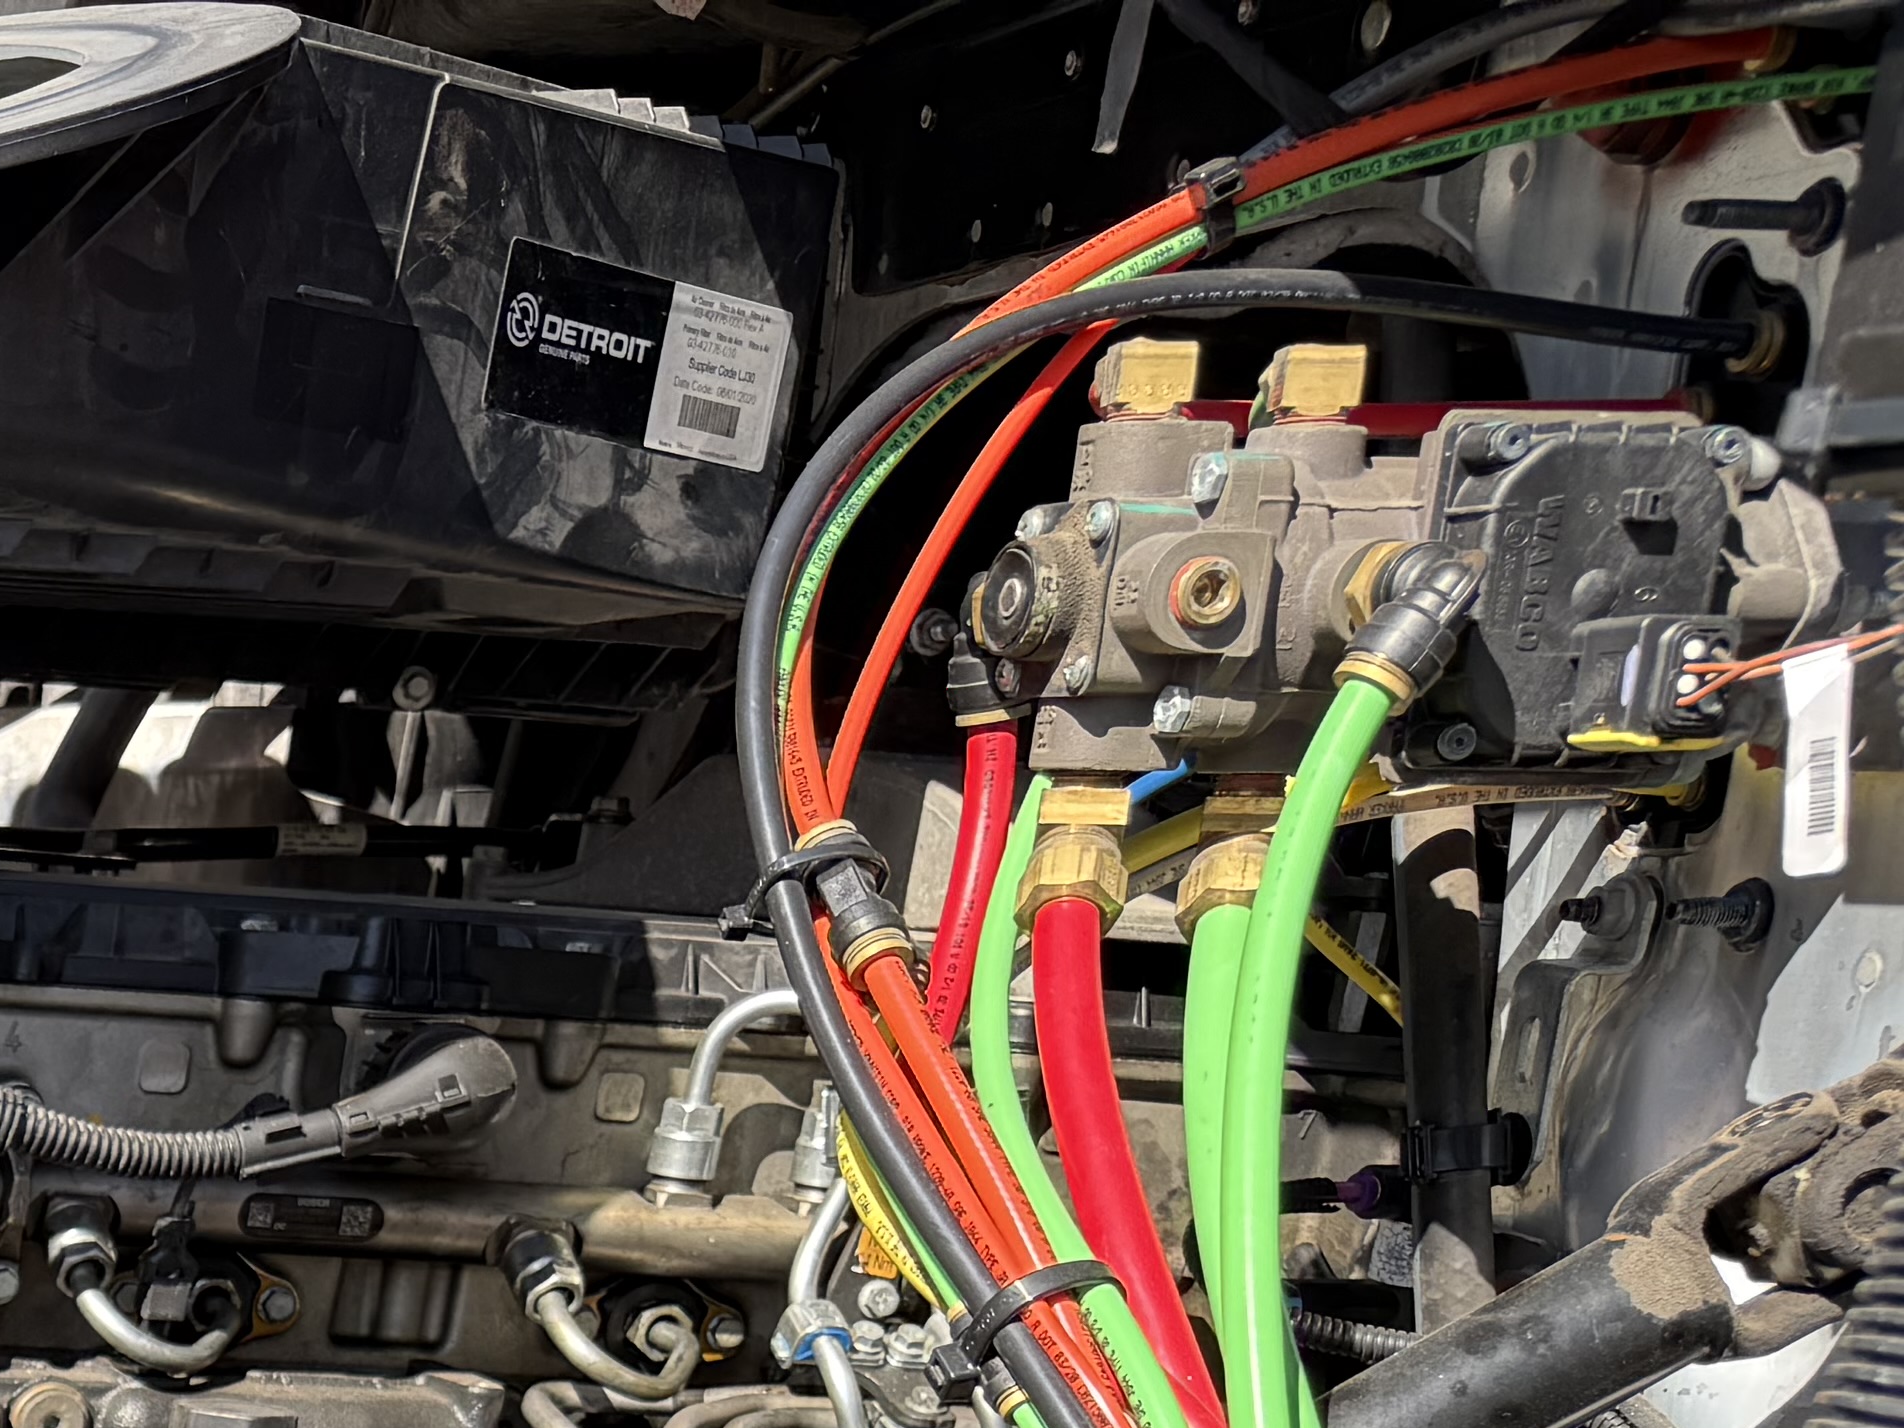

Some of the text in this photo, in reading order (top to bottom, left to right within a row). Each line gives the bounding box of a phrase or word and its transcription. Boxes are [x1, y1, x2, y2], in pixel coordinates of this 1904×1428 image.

[541, 314, 652, 364] DETROIT
[688, 357, 717, 374] Supplier
[718, 364, 737, 380] Code
[673, 375, 690, 389] Date
[1516, 495, 1565, 651] WABCO
[1036, 1328, 1058, 1352] DOT
